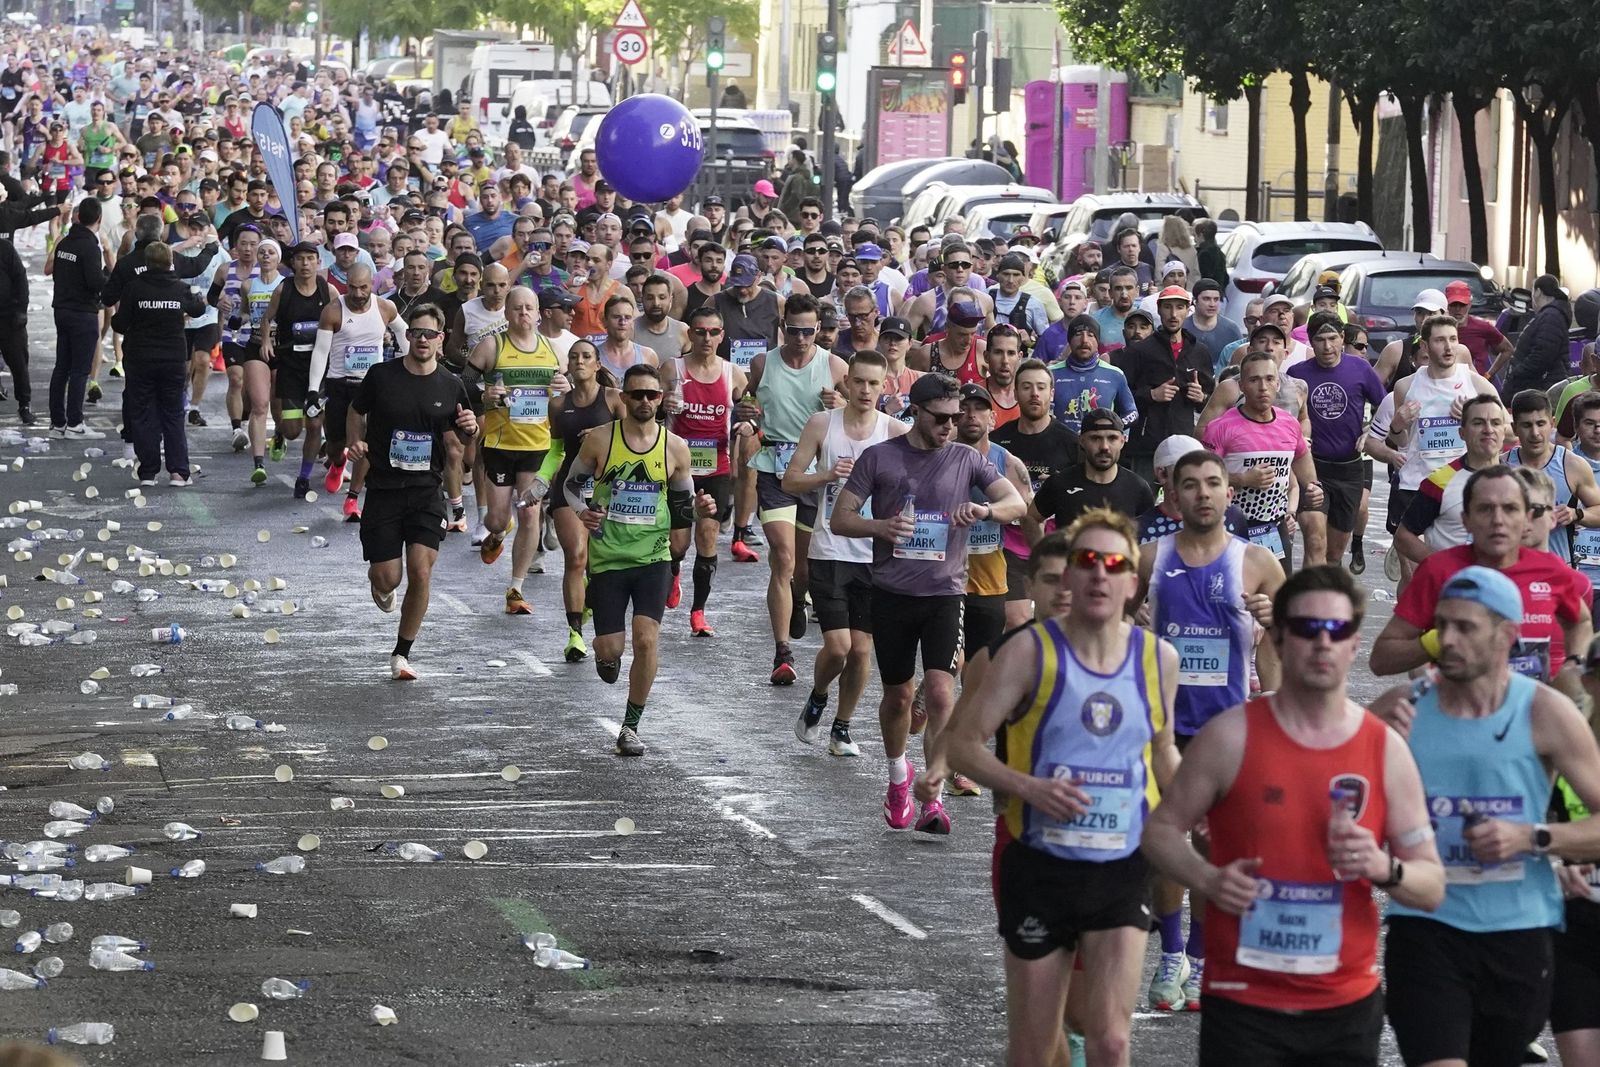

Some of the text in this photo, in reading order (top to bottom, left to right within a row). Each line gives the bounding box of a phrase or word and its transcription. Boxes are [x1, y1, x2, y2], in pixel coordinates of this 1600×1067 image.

[620, 41, 641, 53] 30
[138, 301, 181, 310] VOLUNTEER
[509, 370, 551, 379] CORNWALL
[1318, 386, 1331, 396] XV
[521, 407, 540, 416] JOHN
[685, 413, 715, 421] RUNNING
[1427, 439, 1455, 448] HENRY
[609, 502, 656, 515] JOZZELITO
[914, 513, 943, 521] ZURICH
[905, 537, 936, 548] MARK
[970, 533, 1000, 544] CHRIS!
[1183, 627, 1222, 636] ZURICH
[1184, 644, 1205, 654] 6835
[1180, 657, 1219, 670] ATTEO
[1278, 887, 1333, 899] ZURICH
[1260, 929, 1321, 951] HARRY
